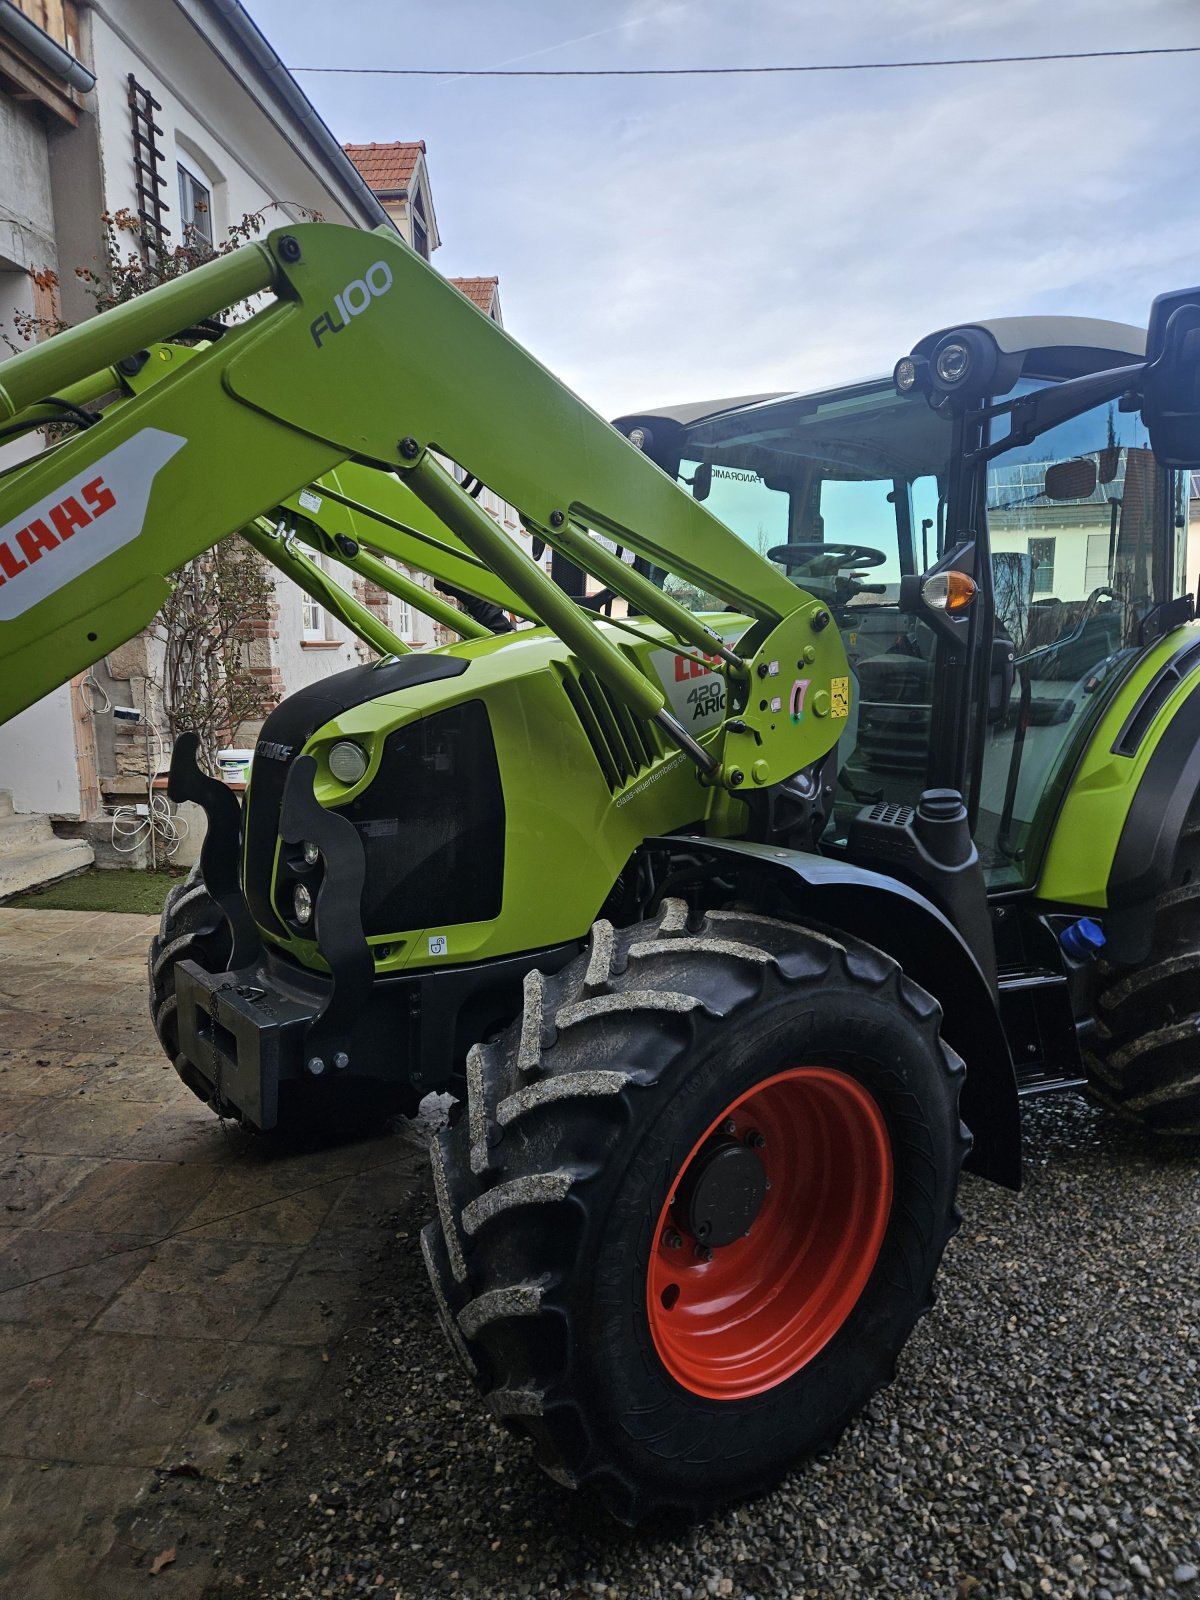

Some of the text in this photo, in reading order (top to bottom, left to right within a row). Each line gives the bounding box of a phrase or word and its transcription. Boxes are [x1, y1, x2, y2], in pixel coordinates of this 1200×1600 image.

[310, 260, 393, 348] FL100
[0, 475, 117, 586] LAAS
[686, 681, 721, 704] 420
